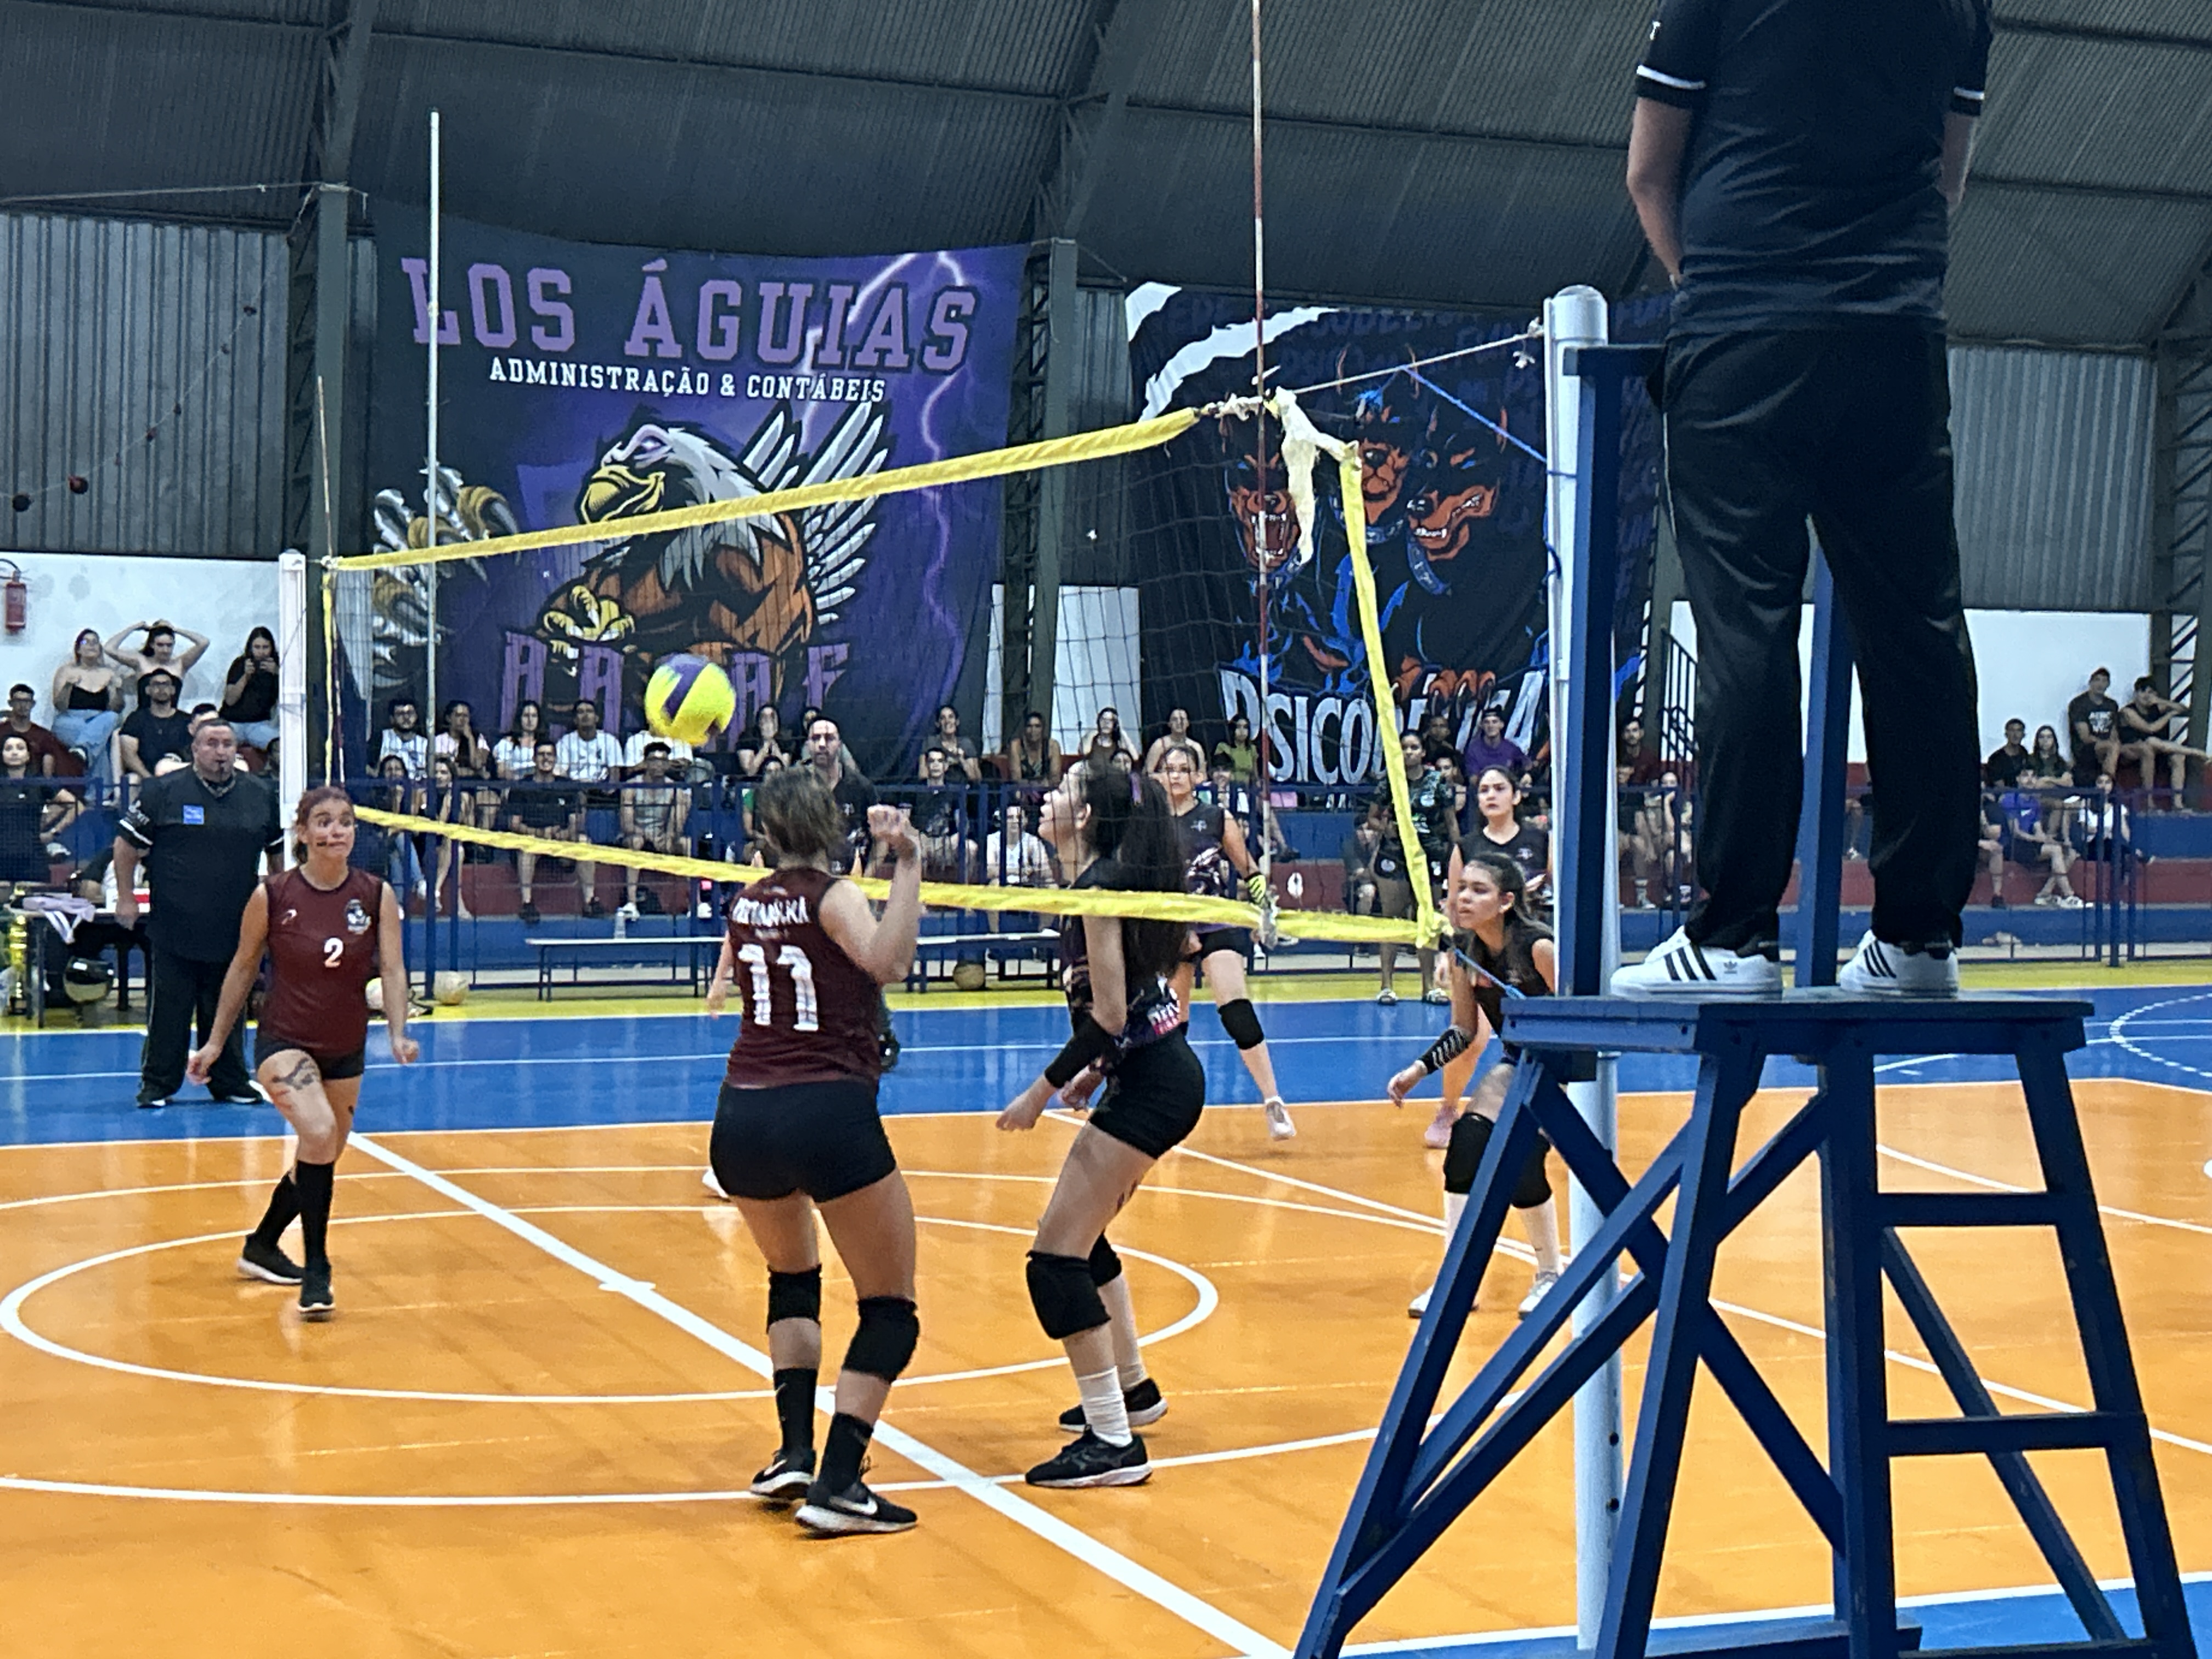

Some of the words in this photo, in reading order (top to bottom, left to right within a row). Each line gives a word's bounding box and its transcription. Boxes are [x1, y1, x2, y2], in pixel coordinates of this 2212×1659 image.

[401, 257, 575, 351] LOS
[624, 258, 975, 371] ÁGUIAS
[489, 356, 709, 397] ADMINISTRAÇÃO
[720, 374, 736, 397] &
[747, 373, 885, 402] CONTÁBEIS
[324, 937, 344, 968] 2
